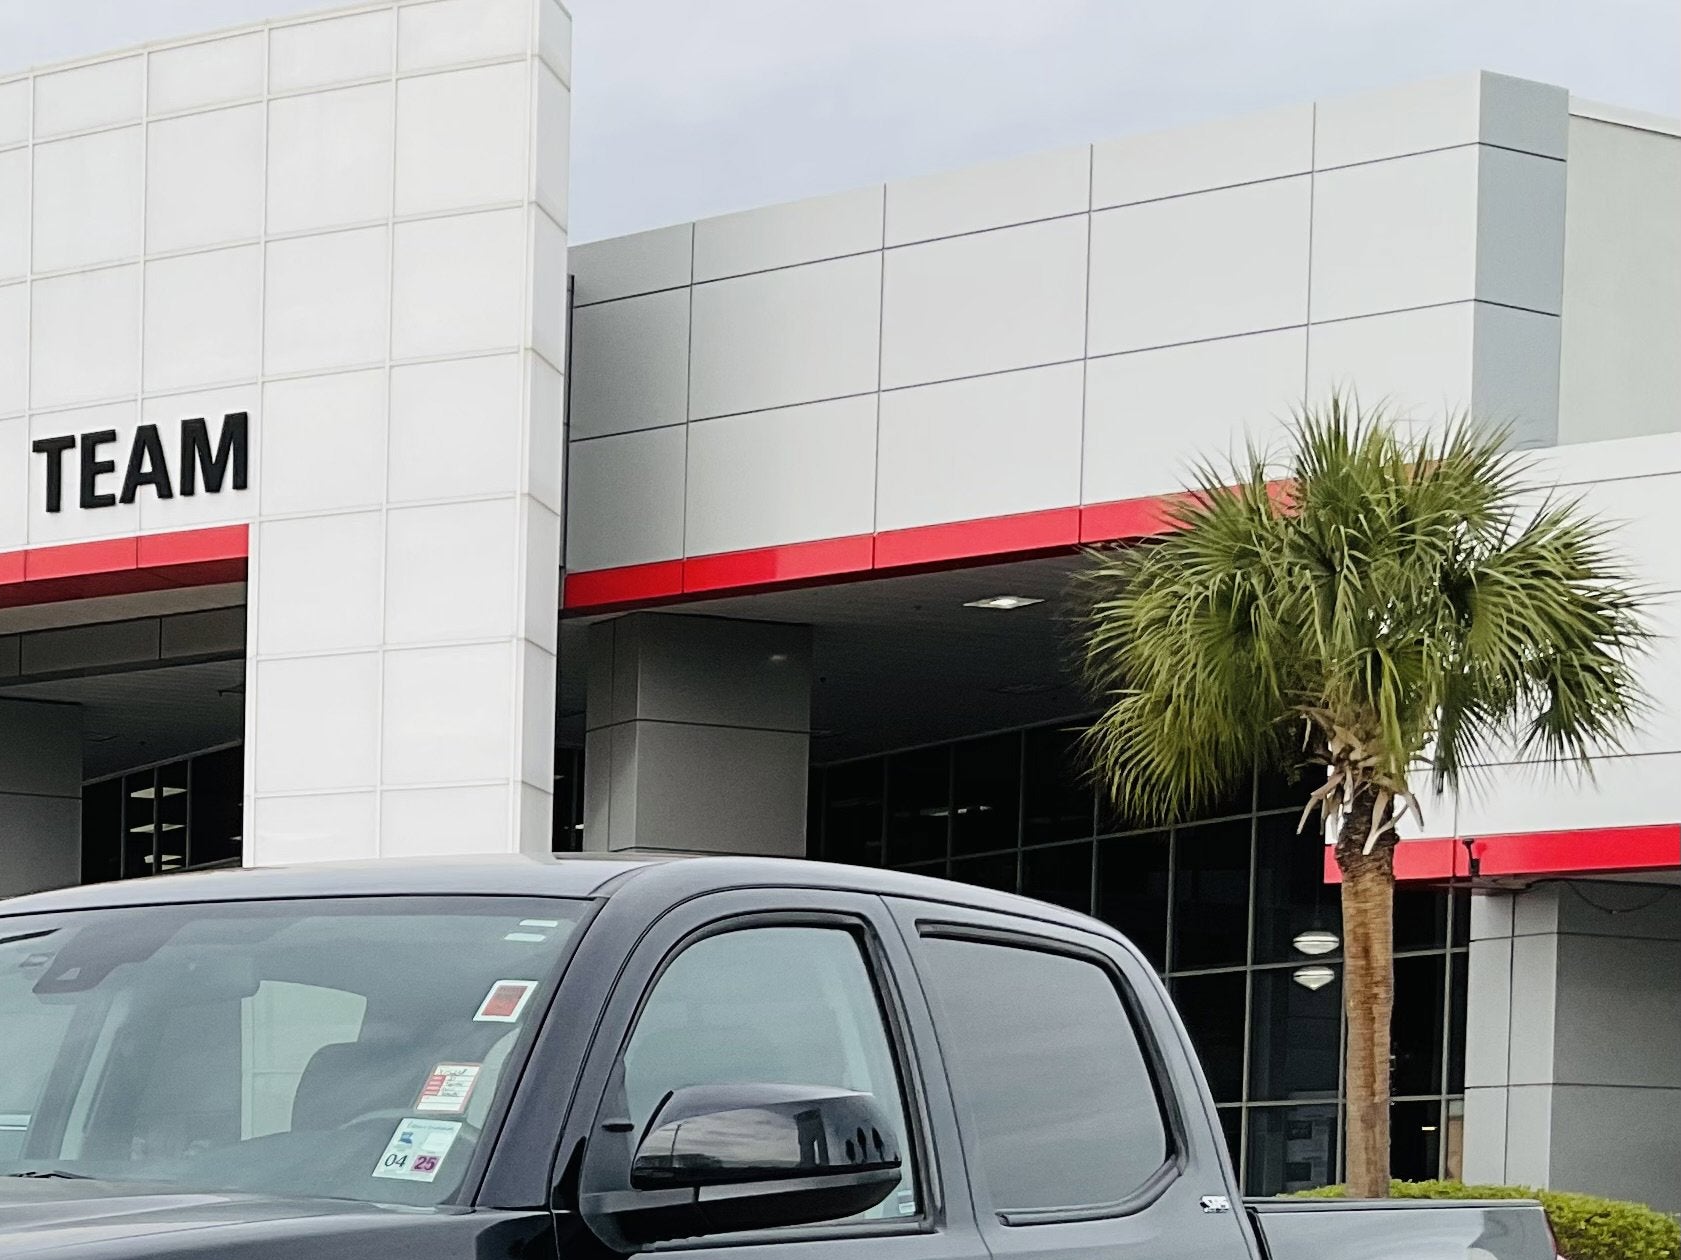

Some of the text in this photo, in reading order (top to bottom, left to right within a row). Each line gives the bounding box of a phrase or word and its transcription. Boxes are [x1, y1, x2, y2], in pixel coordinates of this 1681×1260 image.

[32, 411, 248, 513] TEAM
[384, 1153, 437, 1171] 04 25
